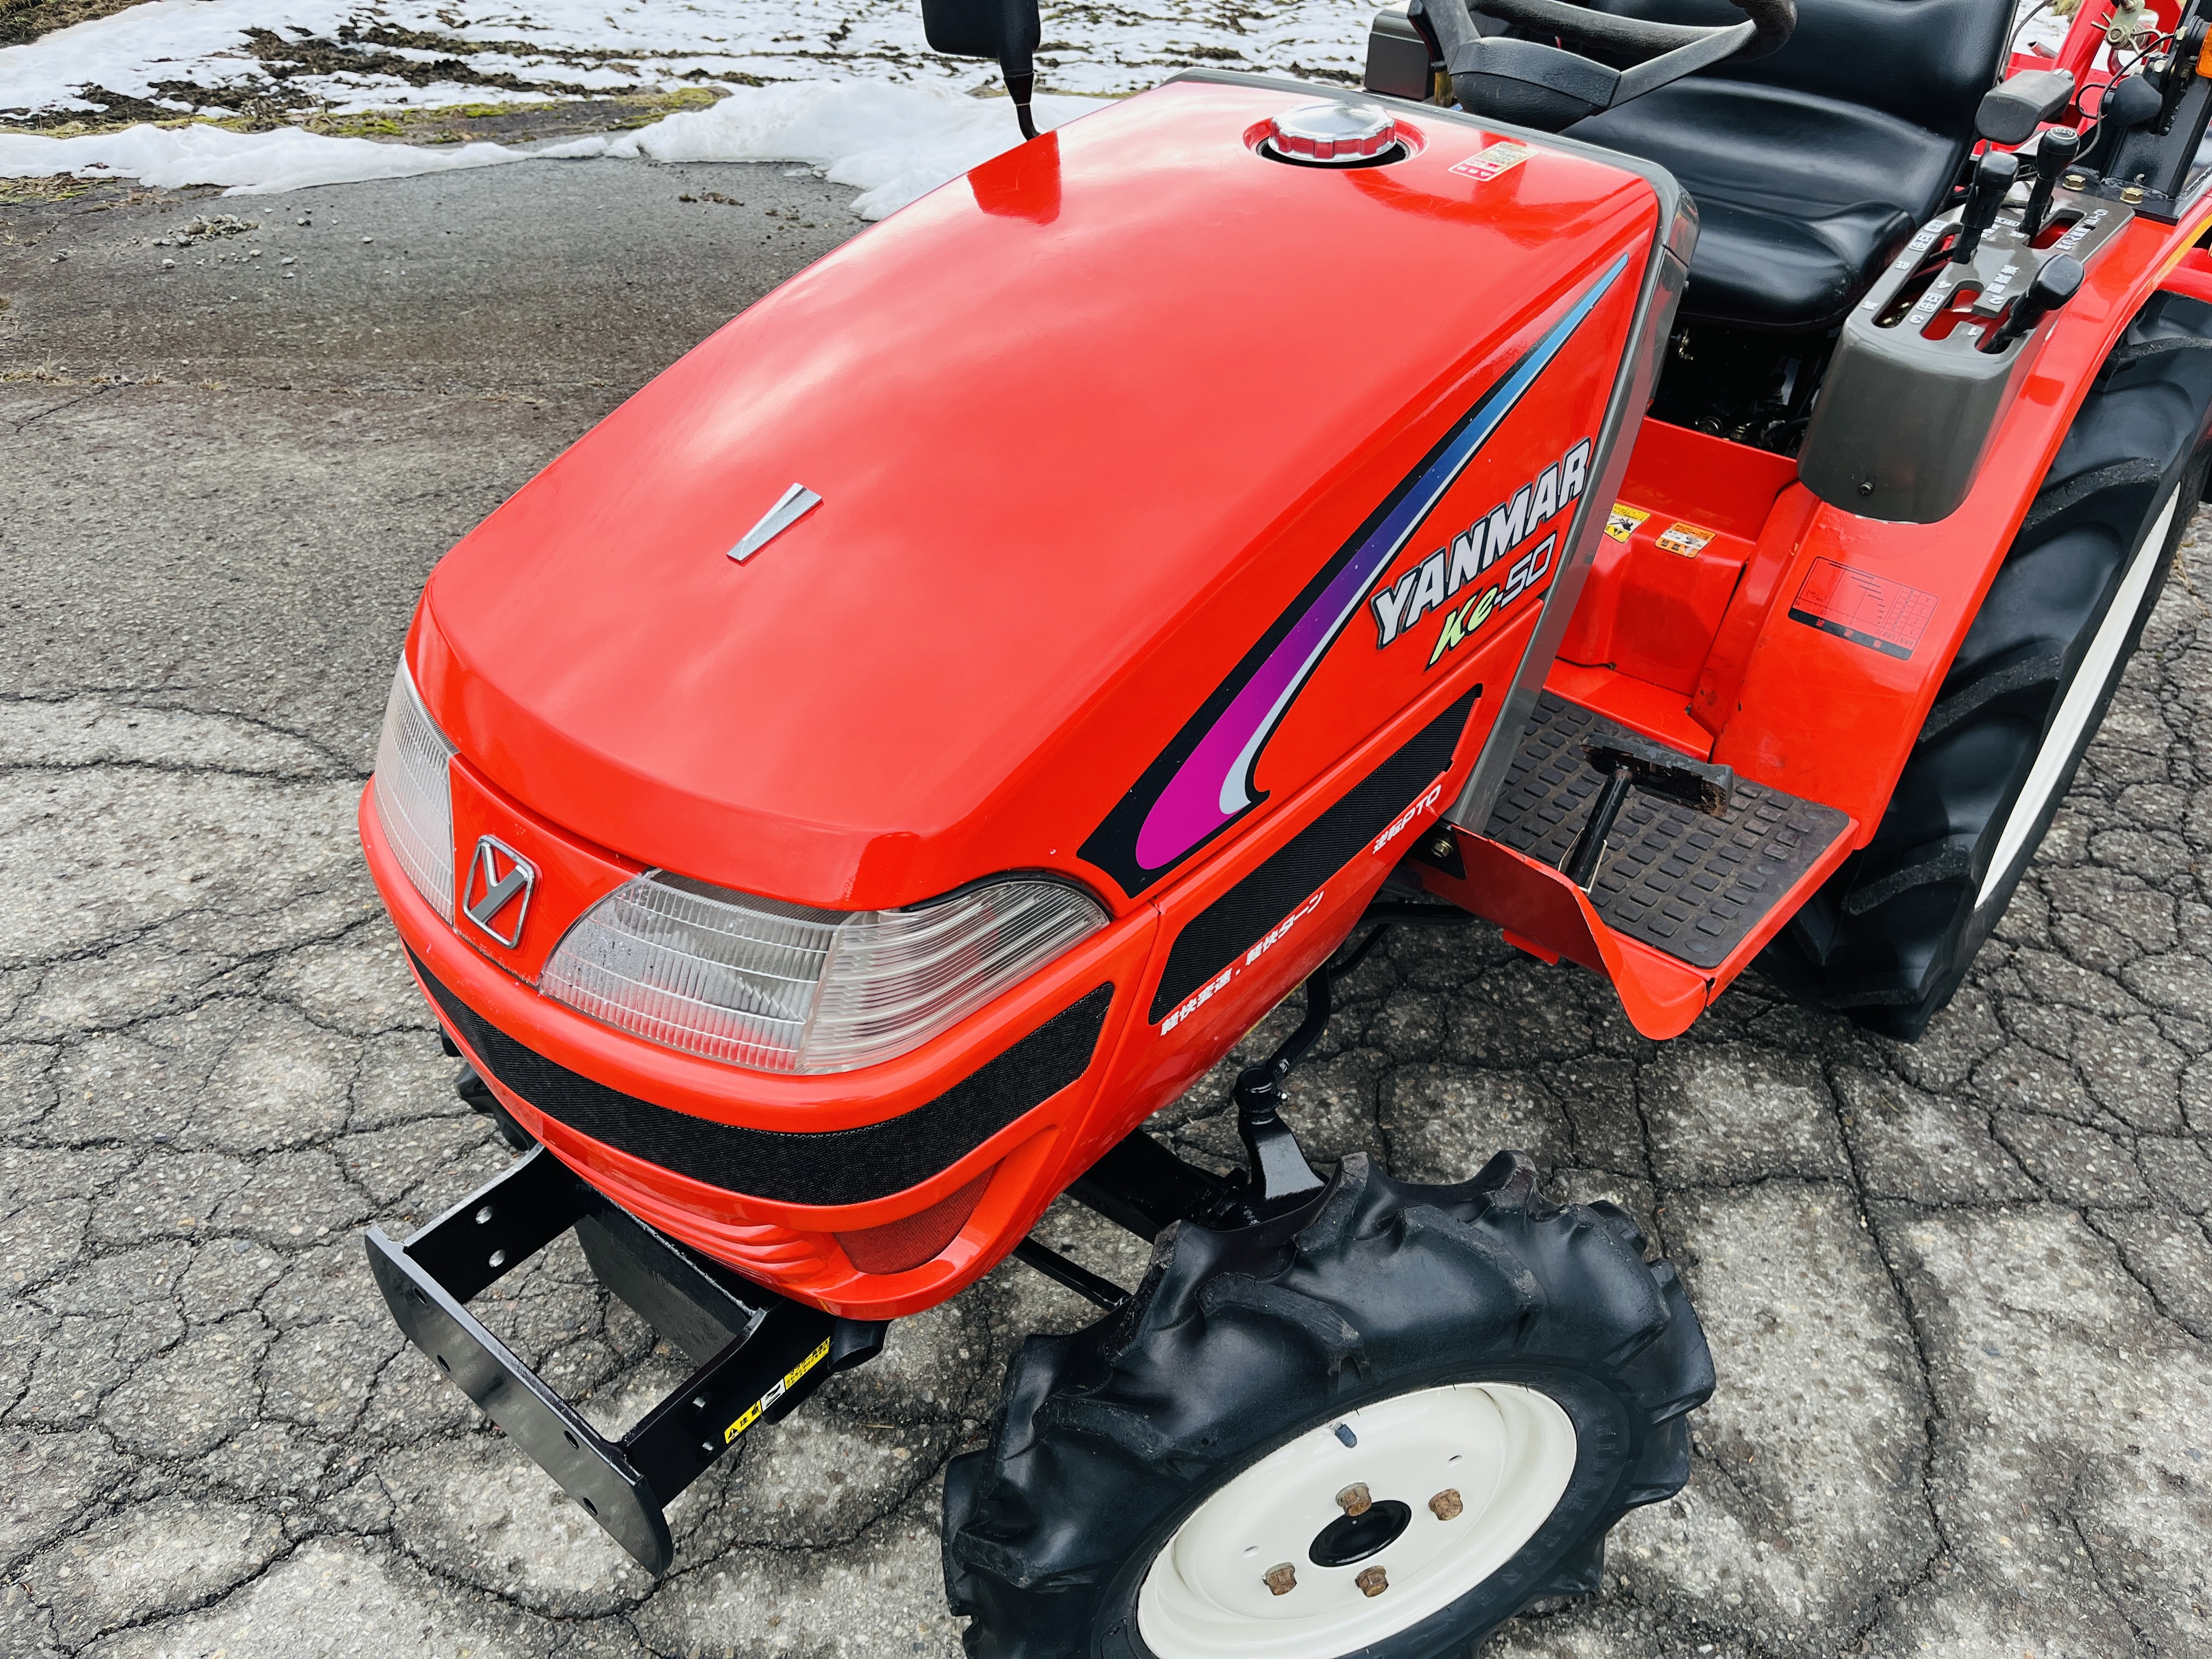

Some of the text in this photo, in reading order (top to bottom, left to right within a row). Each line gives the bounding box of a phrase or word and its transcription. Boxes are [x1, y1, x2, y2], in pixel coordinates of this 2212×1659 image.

[1937, 280, 1953, 289] 4
[1989, 295, 2005, 304] 2
[1909, 314, 1925, 324] 3
[1967, 326, 1978, 336] 1
[1372, 437, 1591, 649] YANMAR
